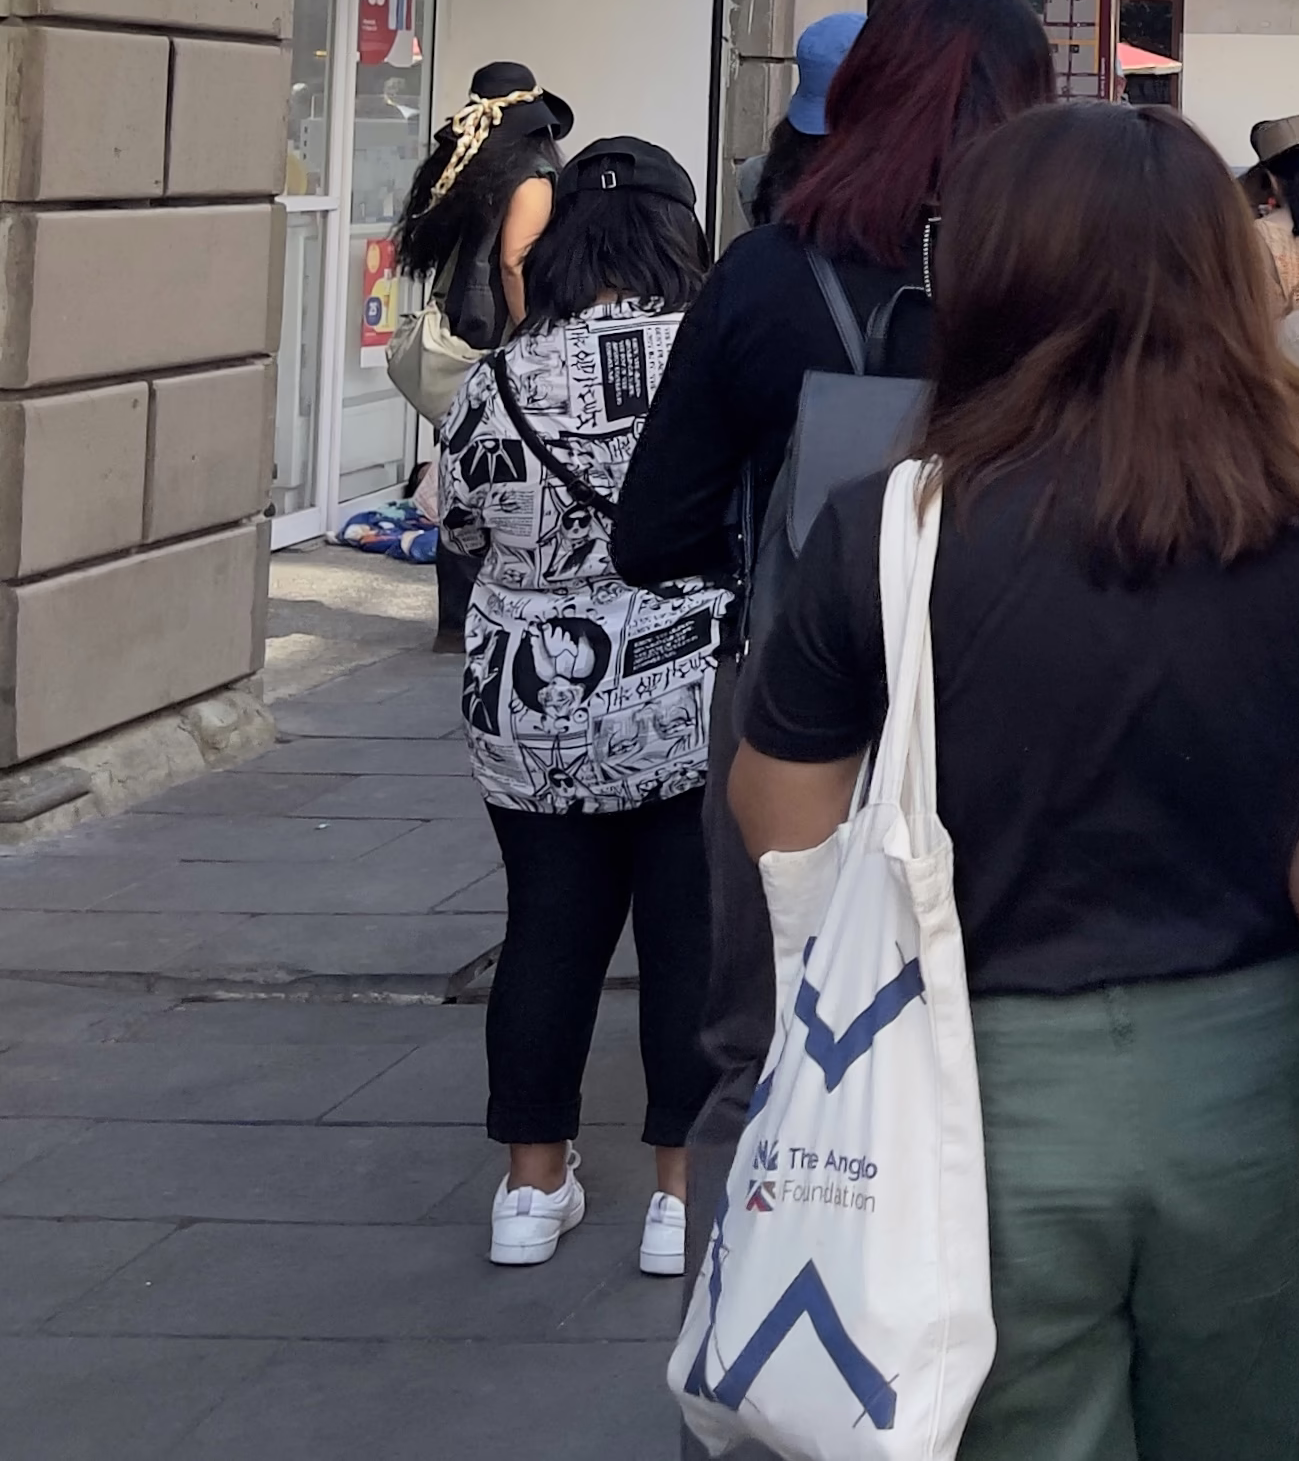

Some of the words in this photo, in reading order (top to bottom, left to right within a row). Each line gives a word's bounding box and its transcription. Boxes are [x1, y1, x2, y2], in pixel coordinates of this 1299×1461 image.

[789, 1147, 819, 1170] The
[824, 1148, 878, 1181] Anglo
[782, 1179, 876, 1213] Foundation
